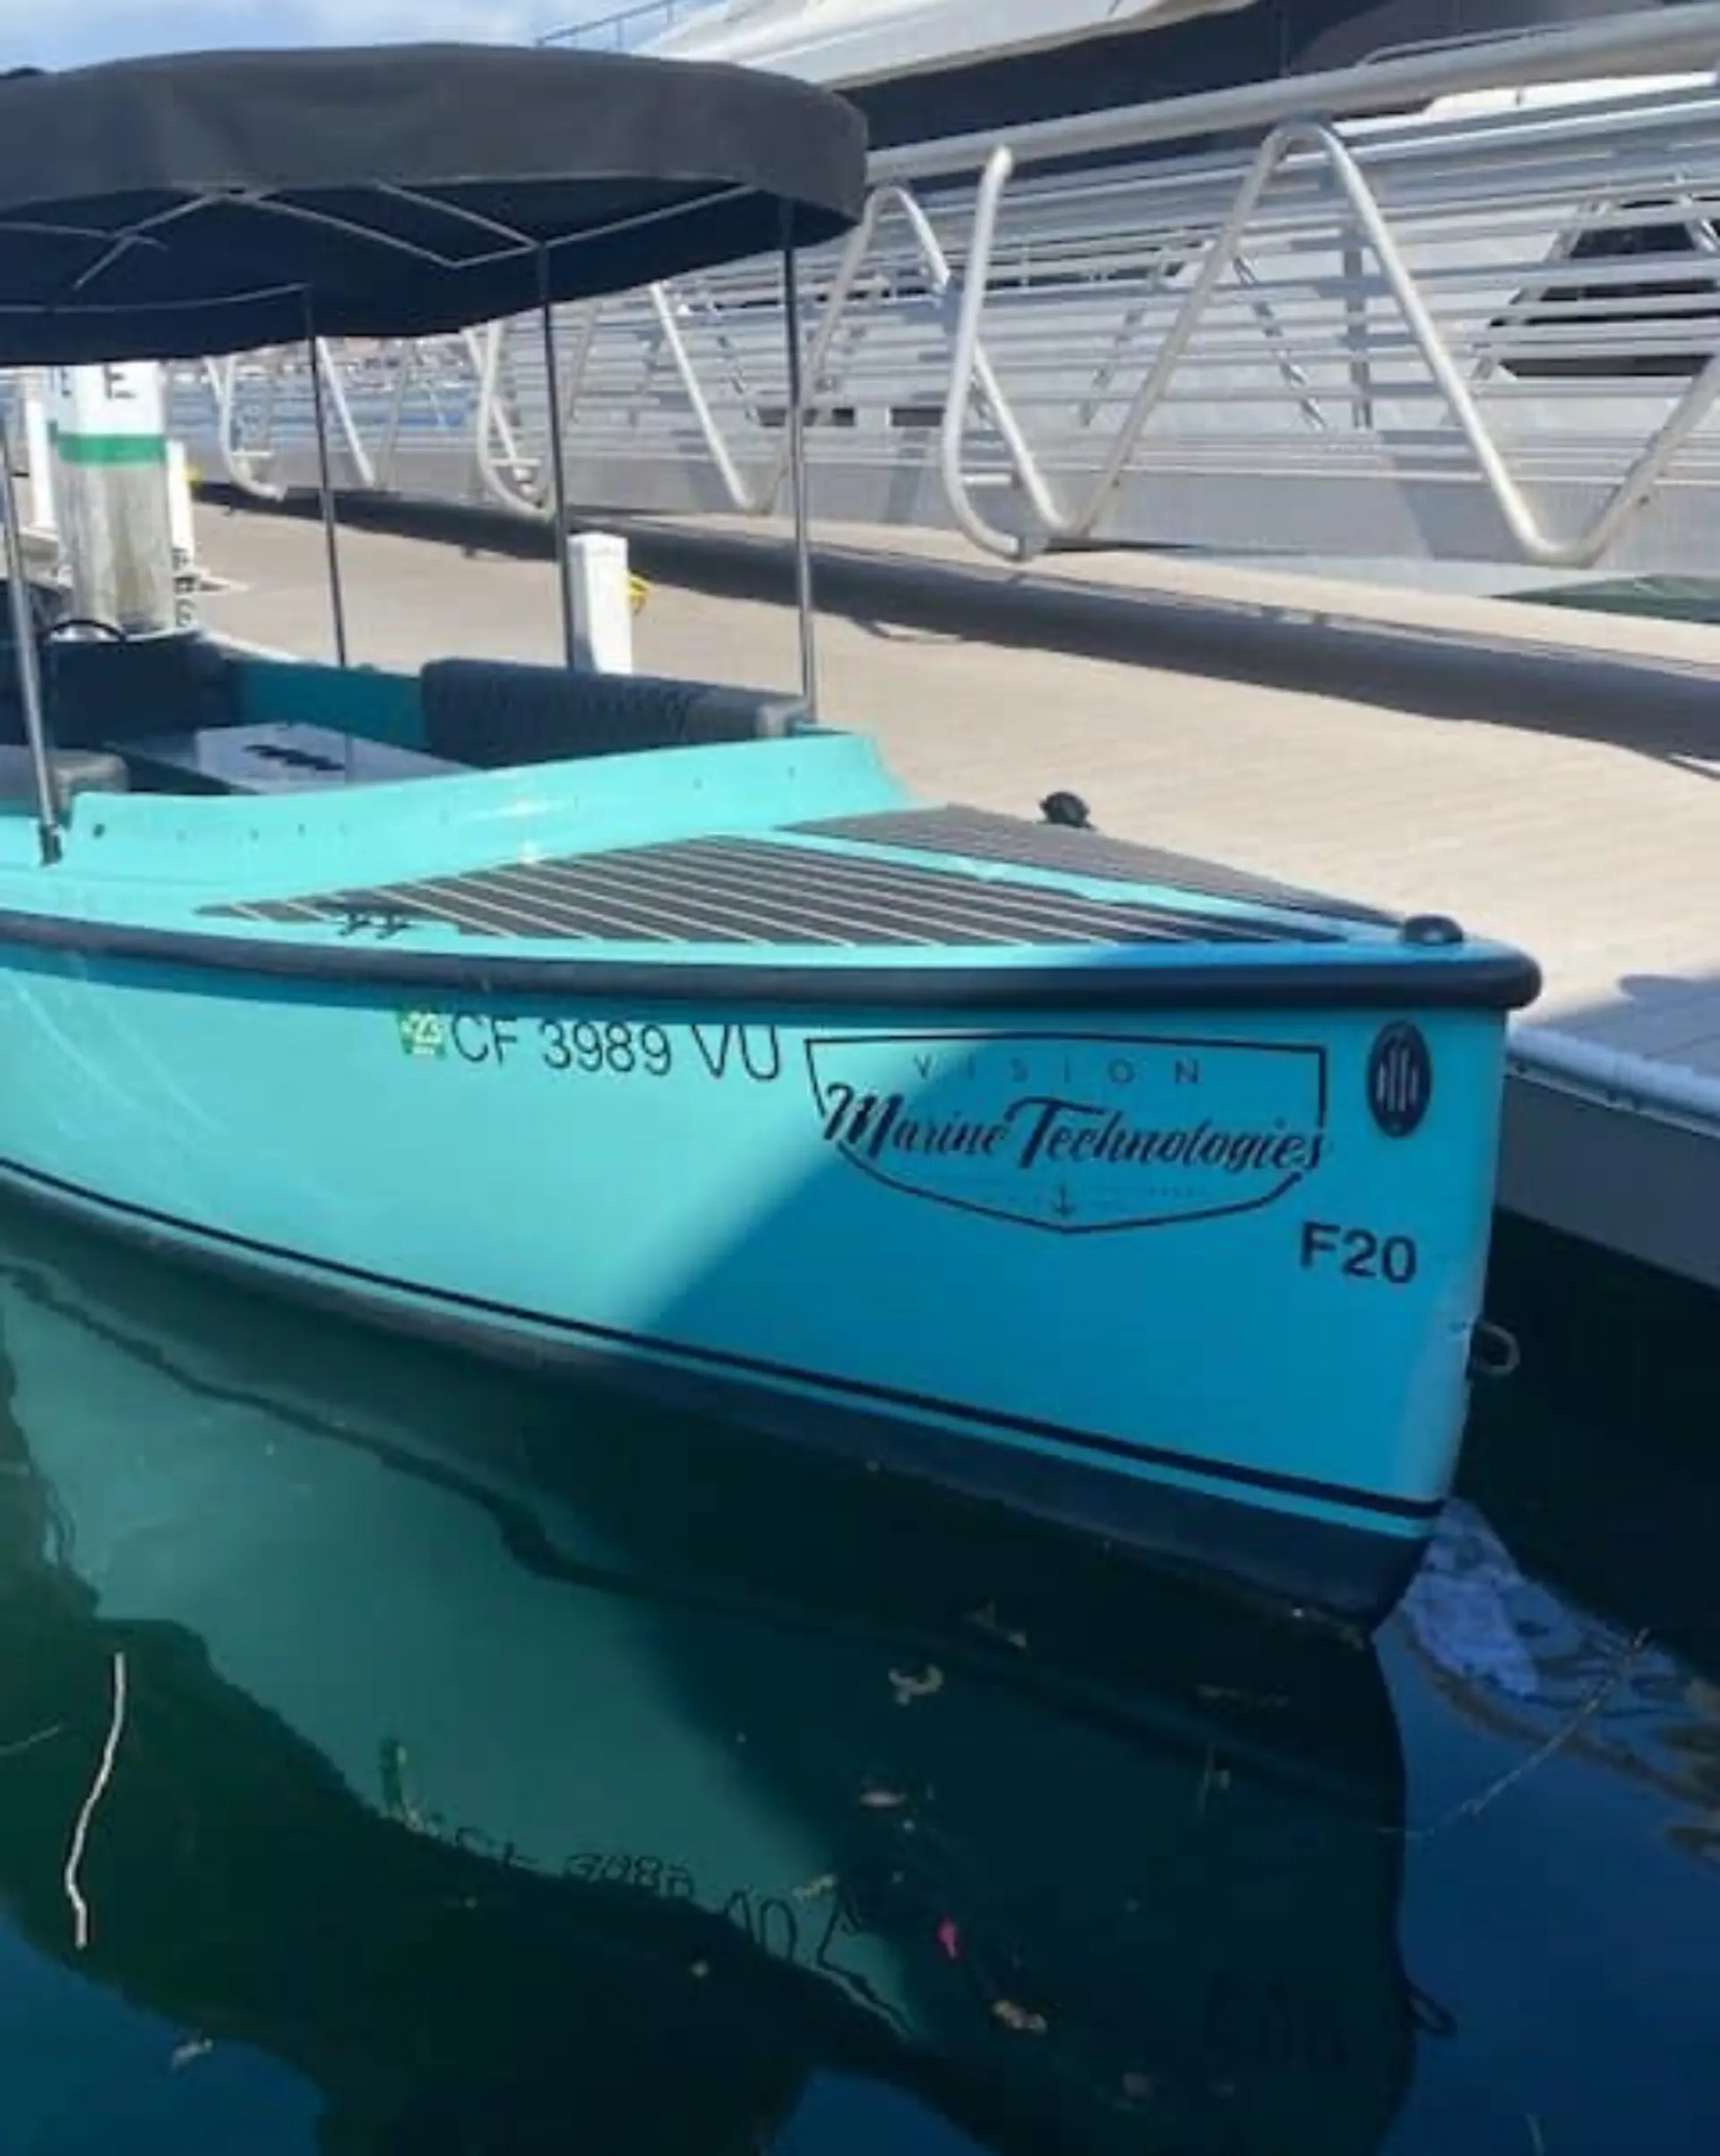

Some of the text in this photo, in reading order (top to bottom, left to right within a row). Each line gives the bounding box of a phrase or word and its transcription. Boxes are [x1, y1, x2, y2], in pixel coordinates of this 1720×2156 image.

[452, 1012, 780, 1080] CF 3989 VU
[912, 1053, 1201, 1087] VISION
[822, 1083, 1324, 1173] Marine Technologies
[1299, 1221, 1418, 1284] F20
